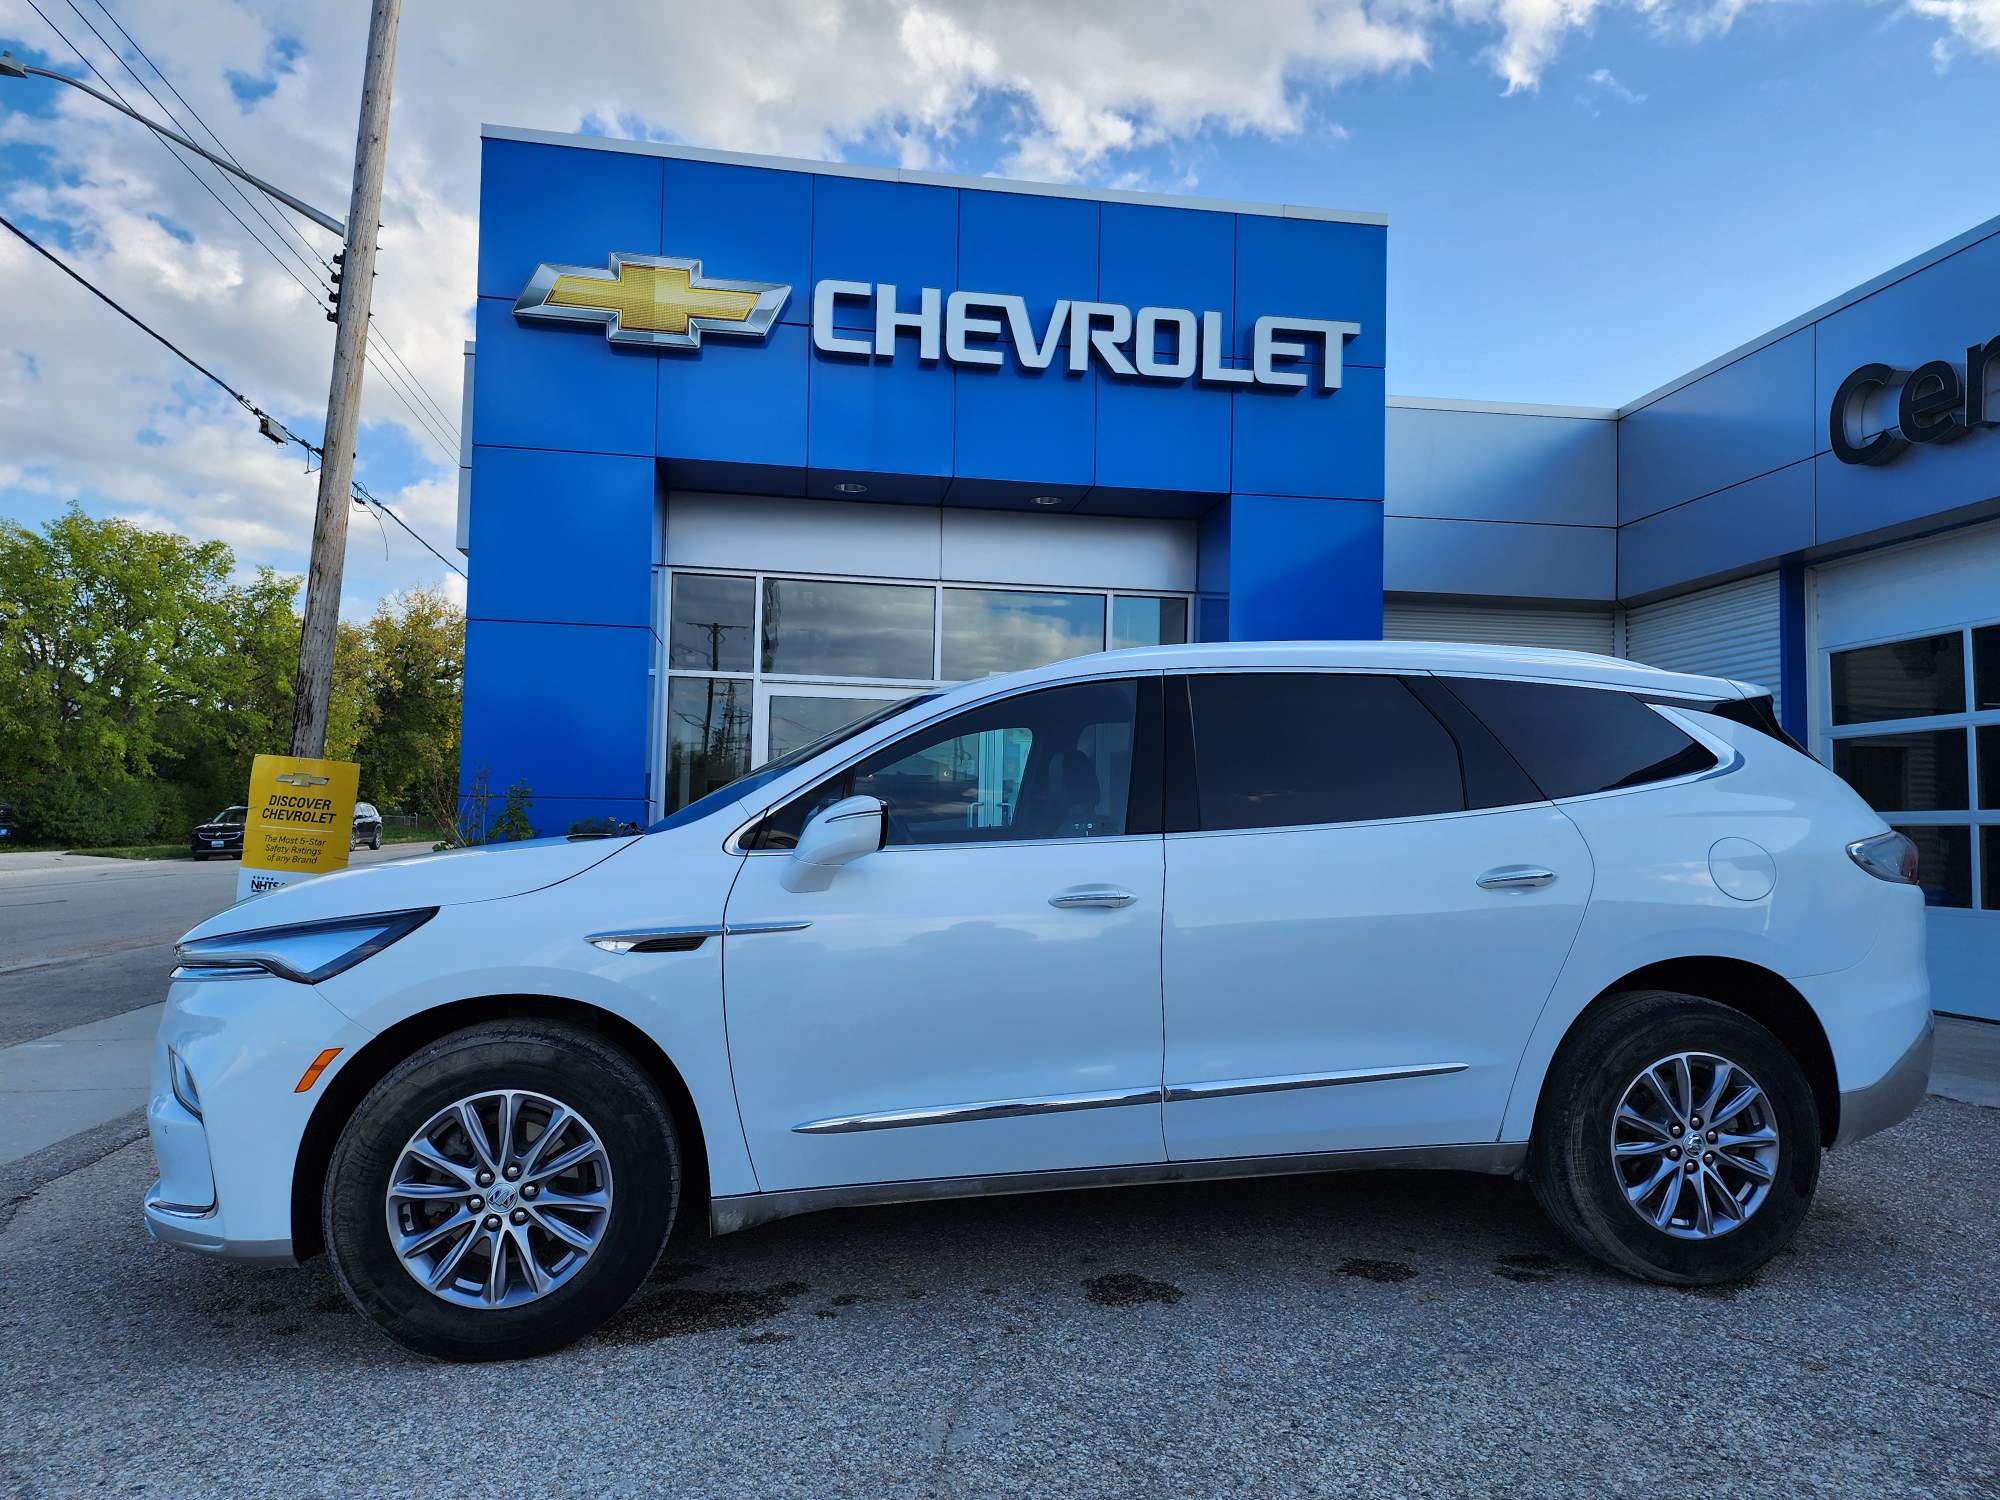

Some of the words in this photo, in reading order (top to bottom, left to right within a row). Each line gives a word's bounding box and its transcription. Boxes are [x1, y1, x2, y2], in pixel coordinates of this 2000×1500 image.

[812, 279, 1362, 391] CHEVROLET
[269, 795, 332, 810] DISCOVER
[262, 808, 337, 824] CHEVROLET
[264, 834, 278, 843] The
[278, 836, 298, 845] Most
[299, 837, 327, 846] 5-Star
[265, 844, 289, 854] Safety
[290, 846, 321, 856] Ratings
[266, 854, 275, 862] of
[275, 856, 290, 864] any
[291, 855, 318, 864] Brand
